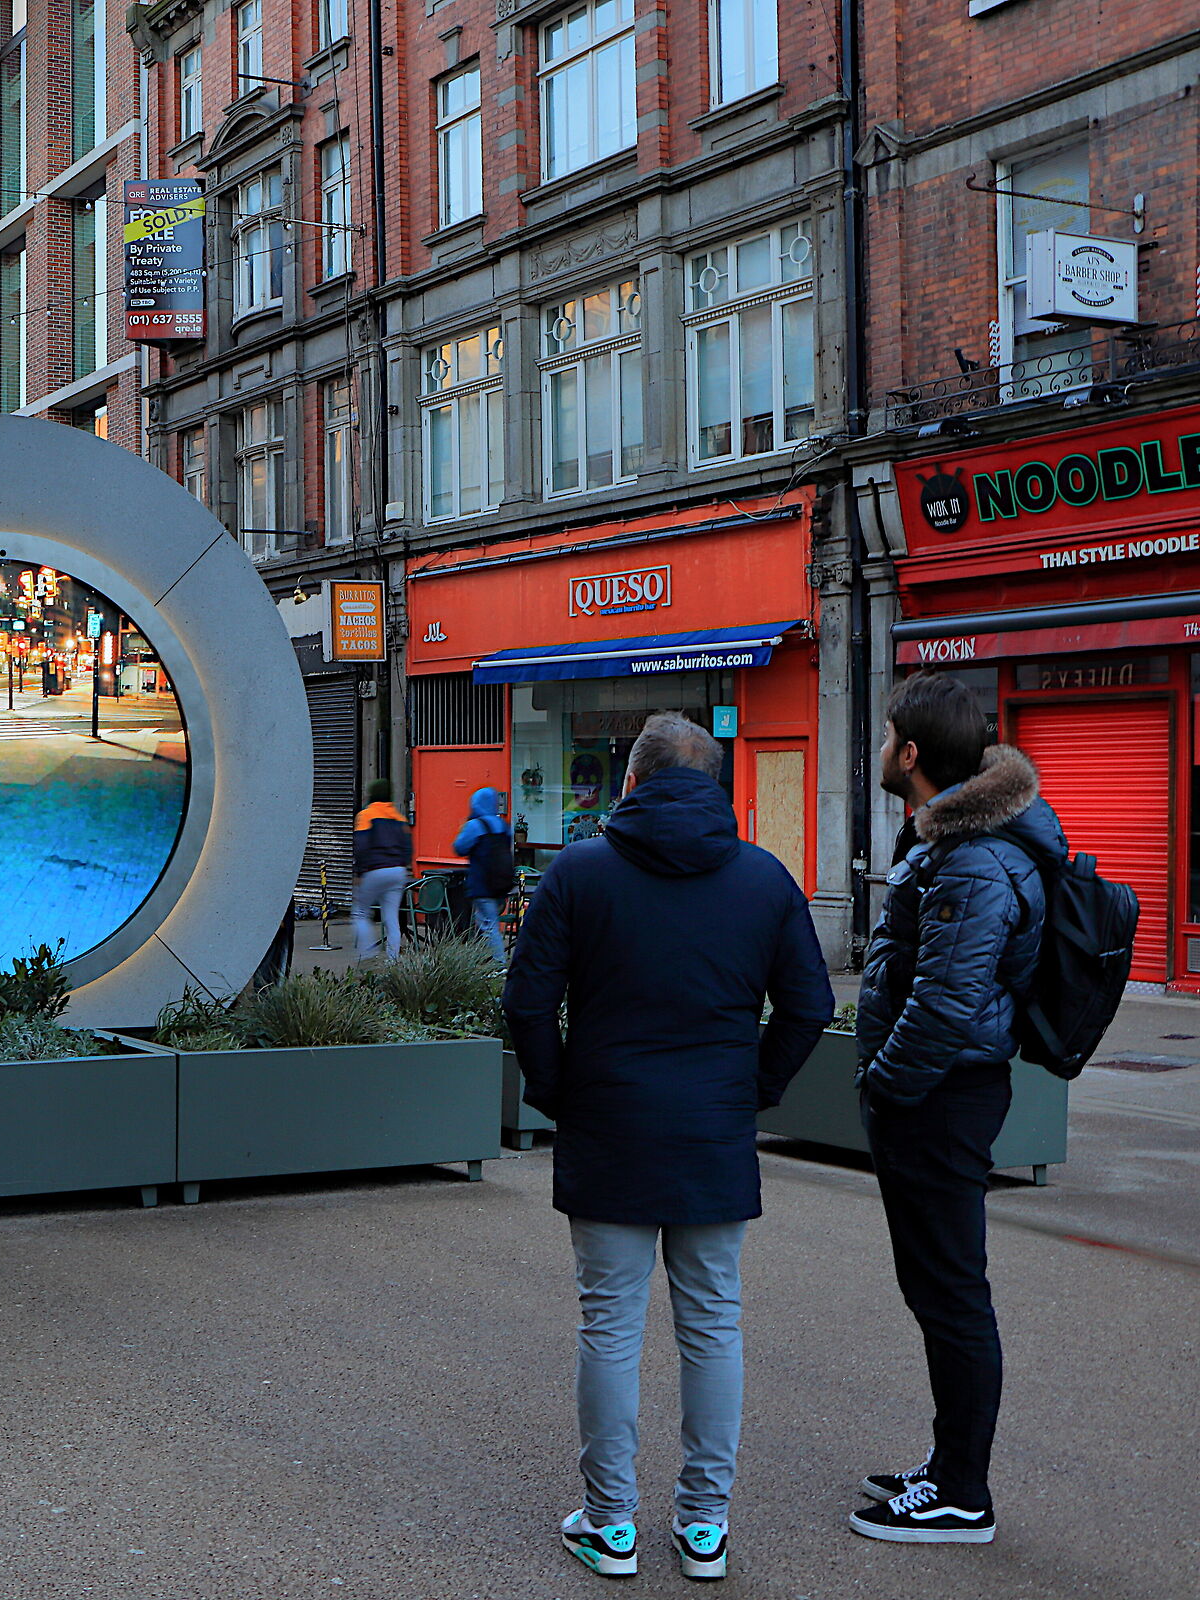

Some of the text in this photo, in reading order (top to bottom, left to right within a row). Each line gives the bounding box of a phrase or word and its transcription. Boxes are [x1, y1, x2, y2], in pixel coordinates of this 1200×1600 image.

[129, 191, 145, 199] QRE
[149, 193, 188, 201] ADVISERS
[143, 209, 186, 233] SOLD
[130, 244, 183, 256] By Private
[129, 255, 163, 267] Treaty
[1065, 264, 1121, 283] BARBER SHOP
[174, 277, 198, 285] Variety
[152, 286, 177, 294] Subject
[129, 313, 203, 326] (01) 637 5555
[174, 323, 202, 334] qre.ie
[926, 497, 961, 518] WOK IN
[934, 517, 957, 527] Noodle Bar
[1040, 532, 1200, 569] THAI STYLE NOODLE
[339, 590, 376, 601] BURRITOS
[575, 572, 664, 616] QUESO
[644, 602, 656, 610] bar
[339, 615, 377, 626] NACHOS
[339, 627, 377, 638] tortillas
[340, 639, 378, 650] TACOS
[631, 652, 753, 673] www.saburritos.com
